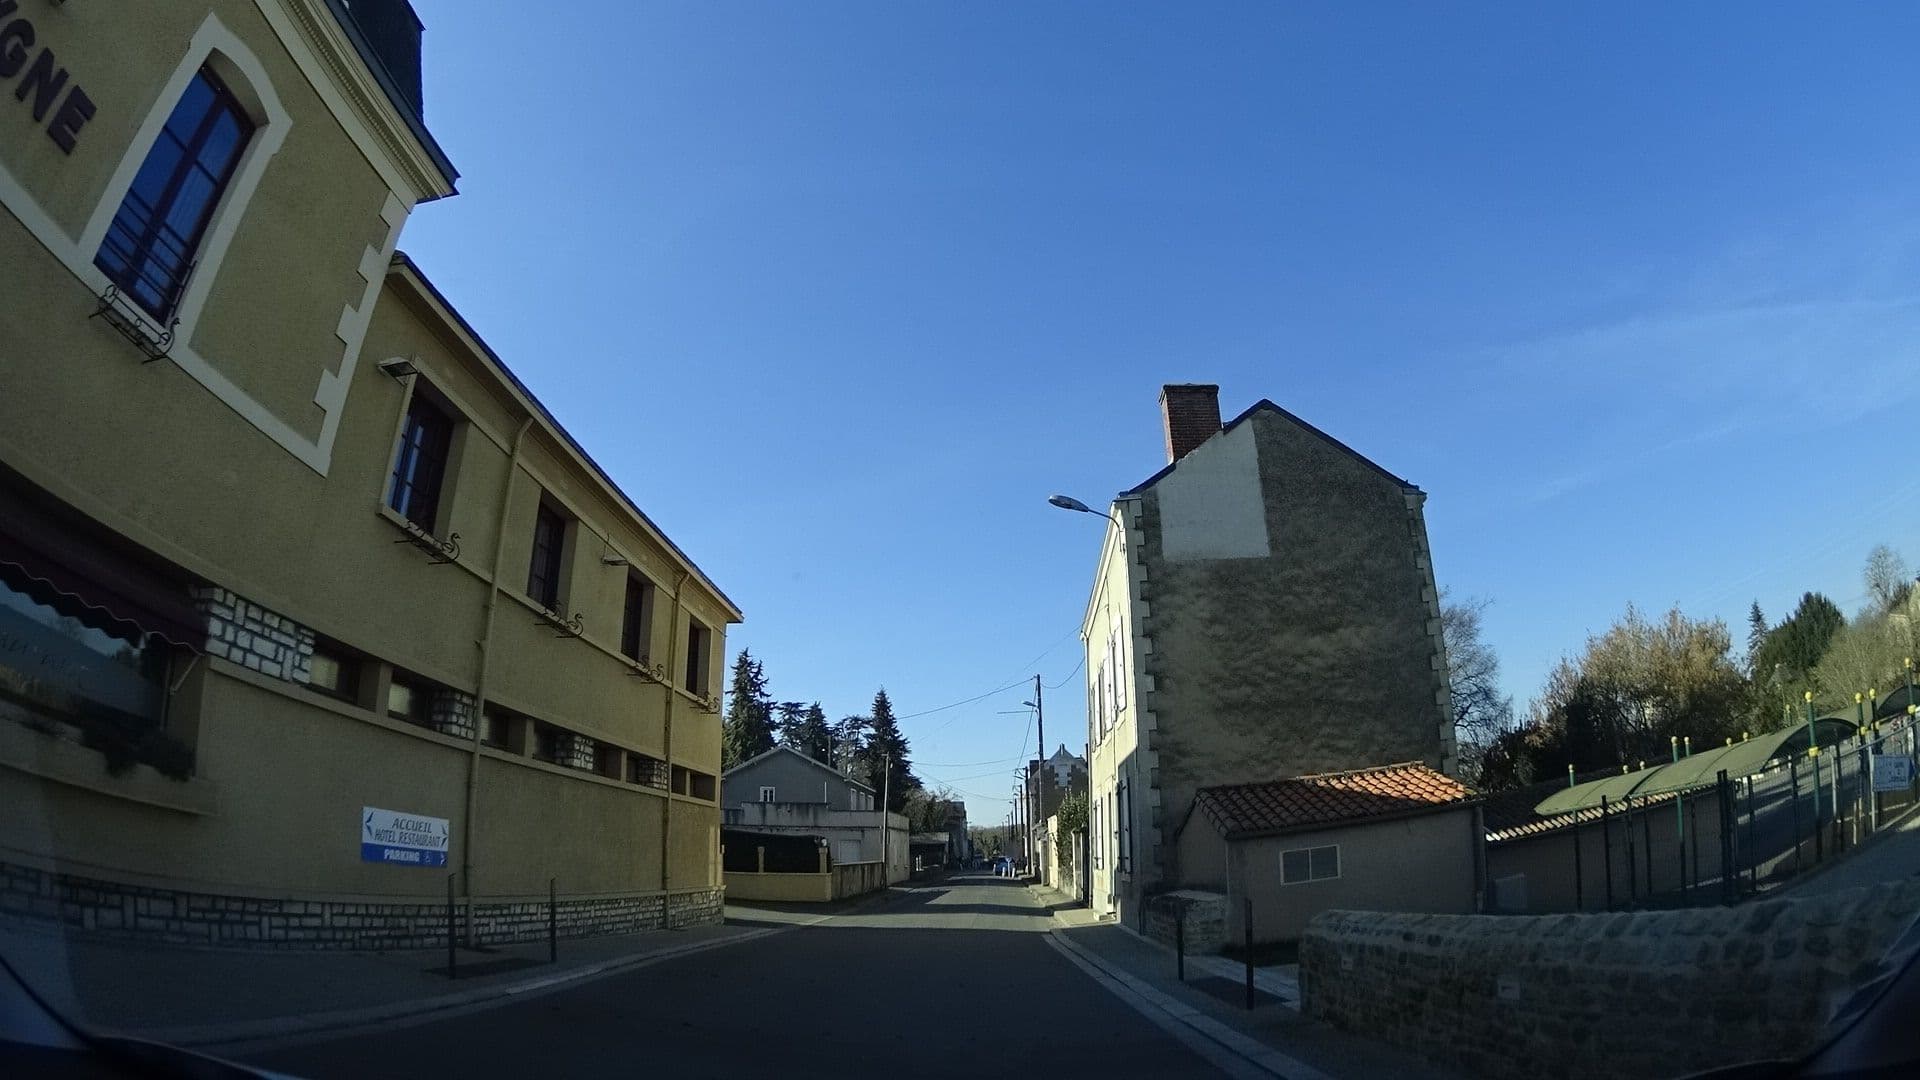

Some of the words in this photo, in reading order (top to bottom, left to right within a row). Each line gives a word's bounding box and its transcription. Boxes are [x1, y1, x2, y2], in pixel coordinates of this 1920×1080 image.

[391, 817, 432, 834] ACCUEIL
[398, 831, 441, 848] RESTAURANT
[384, 848, 420, 862] PARKING
